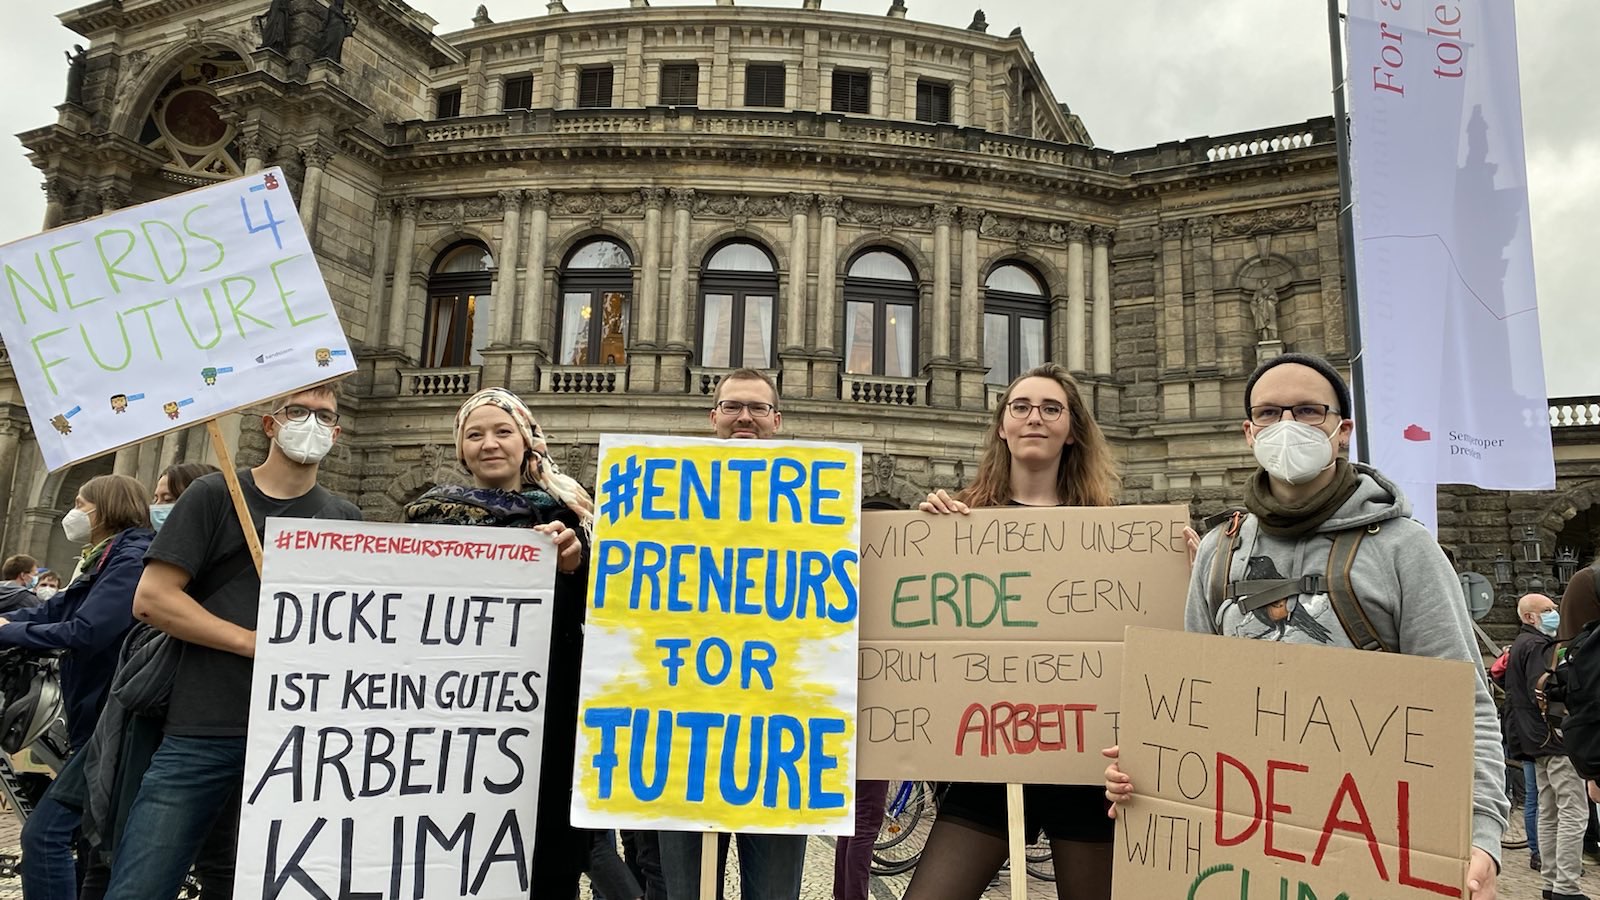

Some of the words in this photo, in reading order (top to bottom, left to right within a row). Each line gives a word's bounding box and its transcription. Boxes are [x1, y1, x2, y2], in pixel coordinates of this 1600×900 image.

[1373, 22, 1405, 97] For
[1427, 0, 1464, 79] tole
[5, 204, 225, 325] NERDS
[240, 195, 286, 251] 4
[31, 253, 329, 396] FUTURE
[599, 454, 847, 526] #ENTRE
[274, 529, 542, 562] #ENTREPRENEURSFORFUTURE
[860, 519, 931, 559] WIR
[954, 518, 1066, 555] HABEN
[1080, 519, 1186, 554] UNSERE
[593, 539, 859, 623] PRENEURS
[890, 571, 1040, 628] ERDE
[268, 590, 403, 645] DICKE
[420, 593, 543, 647] LUFT
[268, 672, 330, 712] IST
[341, 669, 427, 711] KEIN
[435, 670, 542, 713] GUTES
[655, 636, 778, 690] FOR
[858, 646, 938, 684] DRUM
[952, 650, 1104, 684] BLEIBEN
[861, 706, 932, 744] DER
[954, 701, 1098, 757] ARBEIT
[1144, 673, 1213, 729] WE
[1254, 686, 1435, 768] HAVE
[247, 725, 530, 805] ARBEITS
[584, 707, 846, 810] FUTURE
[261, 808, 529, 900] KLIMA
[1123, 808, 1202, 876] WITH
[1142, 742, 1208, 800] TO
[1215, 751, 1463, 899] DEAL
